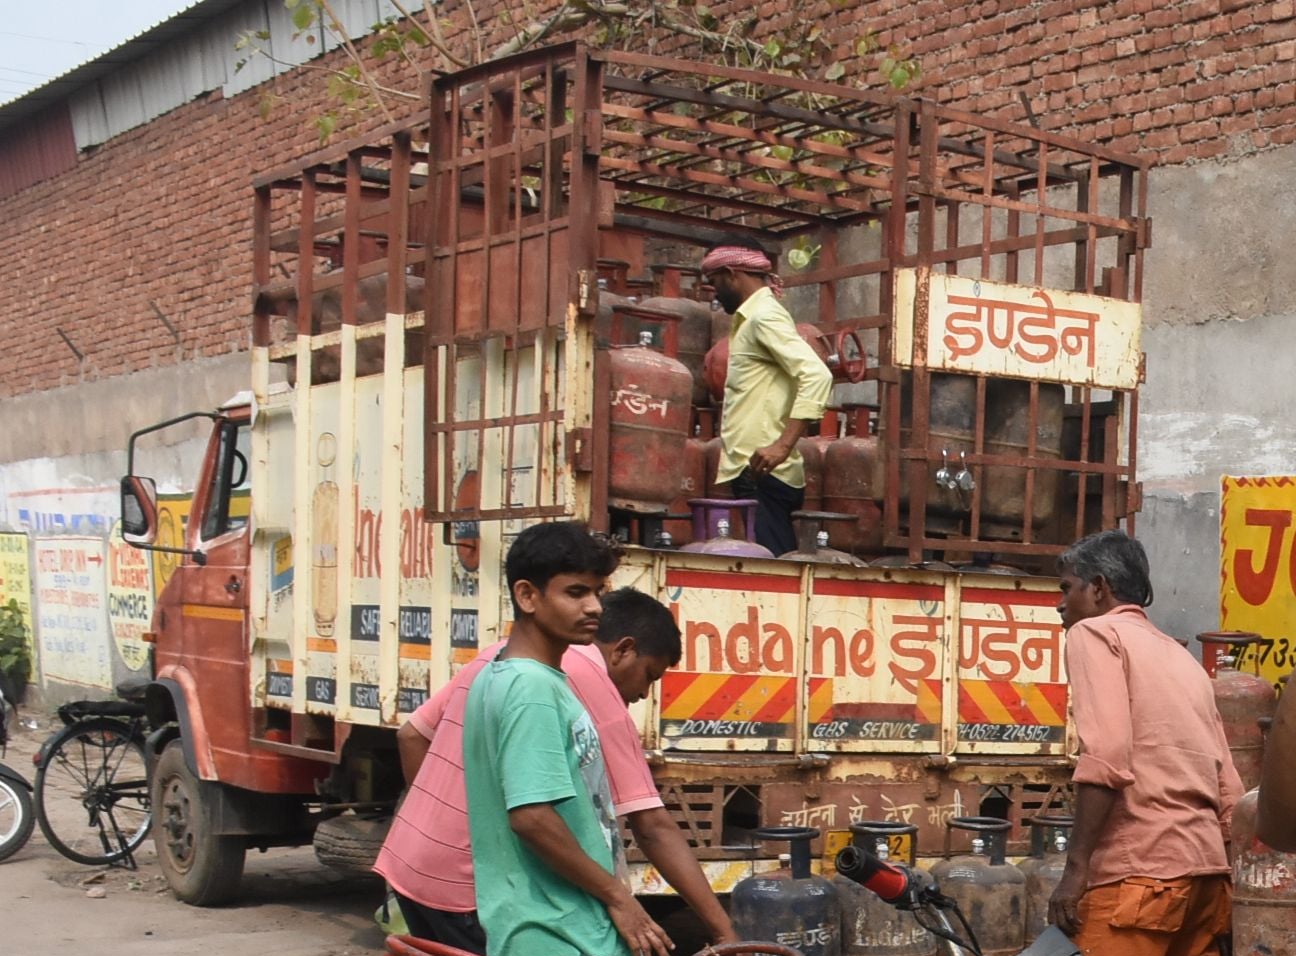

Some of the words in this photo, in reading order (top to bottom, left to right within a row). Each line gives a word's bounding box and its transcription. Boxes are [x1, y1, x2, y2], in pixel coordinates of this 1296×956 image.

[943, 291, 1100, 368] इण्डेन
[887, 604, 1064, 697] इण्डेन
[681, 719, 761, 737] DOMESTIC
[813, 722, 846, 739] GAS
[859, 721, 920, 740] SERVICE
